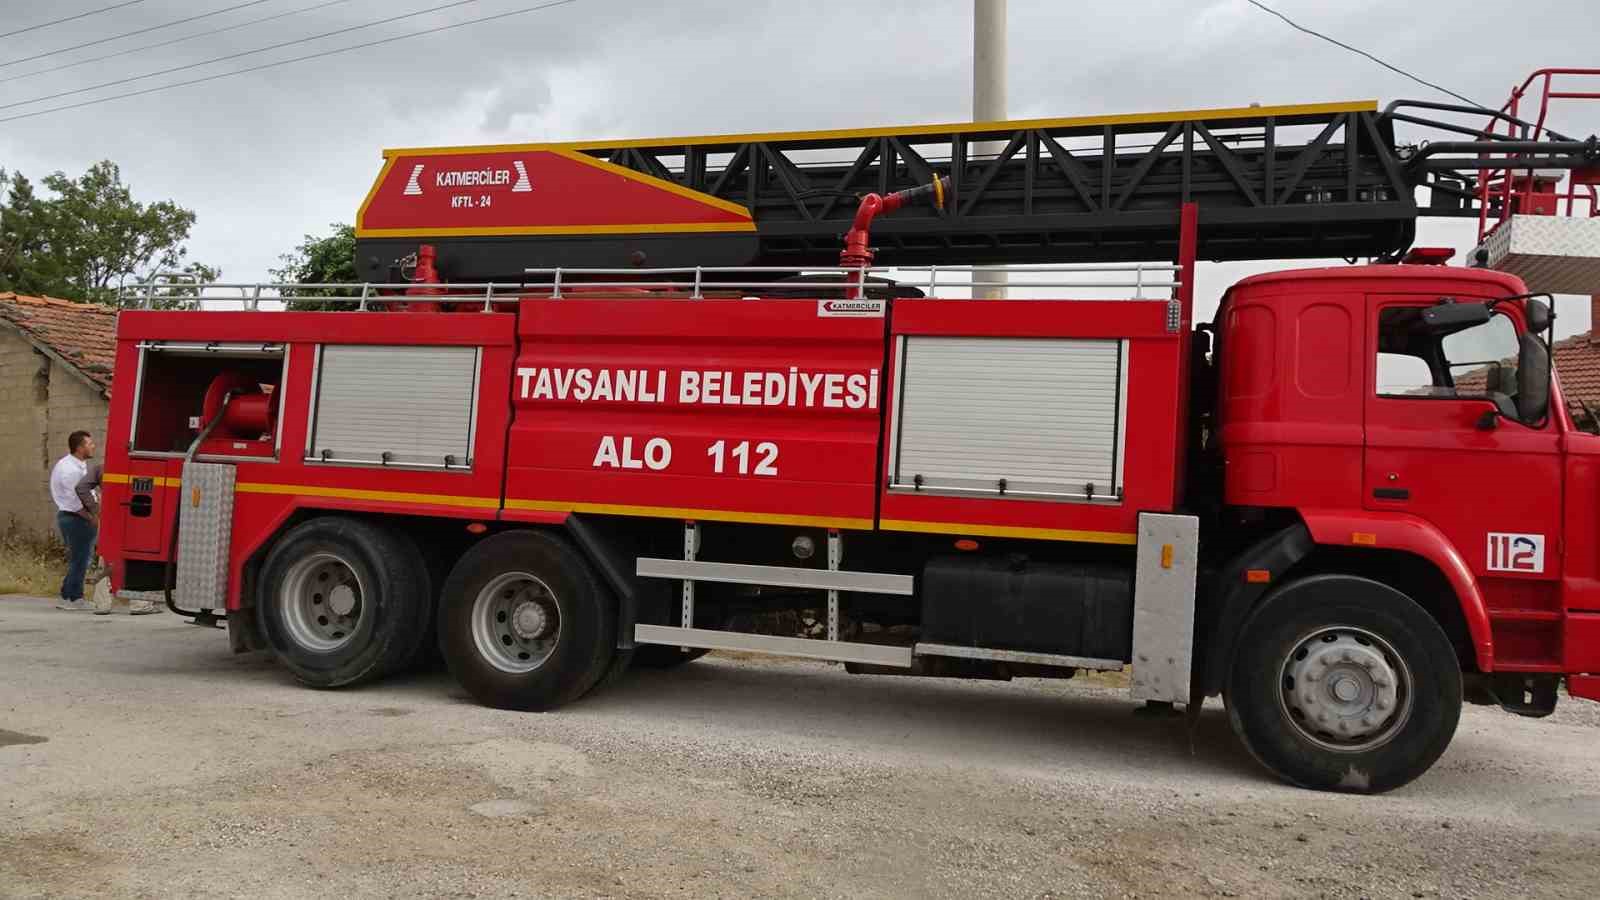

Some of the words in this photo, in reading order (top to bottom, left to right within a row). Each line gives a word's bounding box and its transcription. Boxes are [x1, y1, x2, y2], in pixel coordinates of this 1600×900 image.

[436, 167, 510, 186] KATMERCİLER
[451, 196, 474, 208] KFTL
[480, 195, 491, 207] 24
[517, 367, 667, 403] TAVŞANLI
[679, 366, 880, 409] BELEDİYESİ
[592, 435, 672, 470] ALO
[707, 439, 779, 476] 112
[1490, 535, 1536, 570] 112
